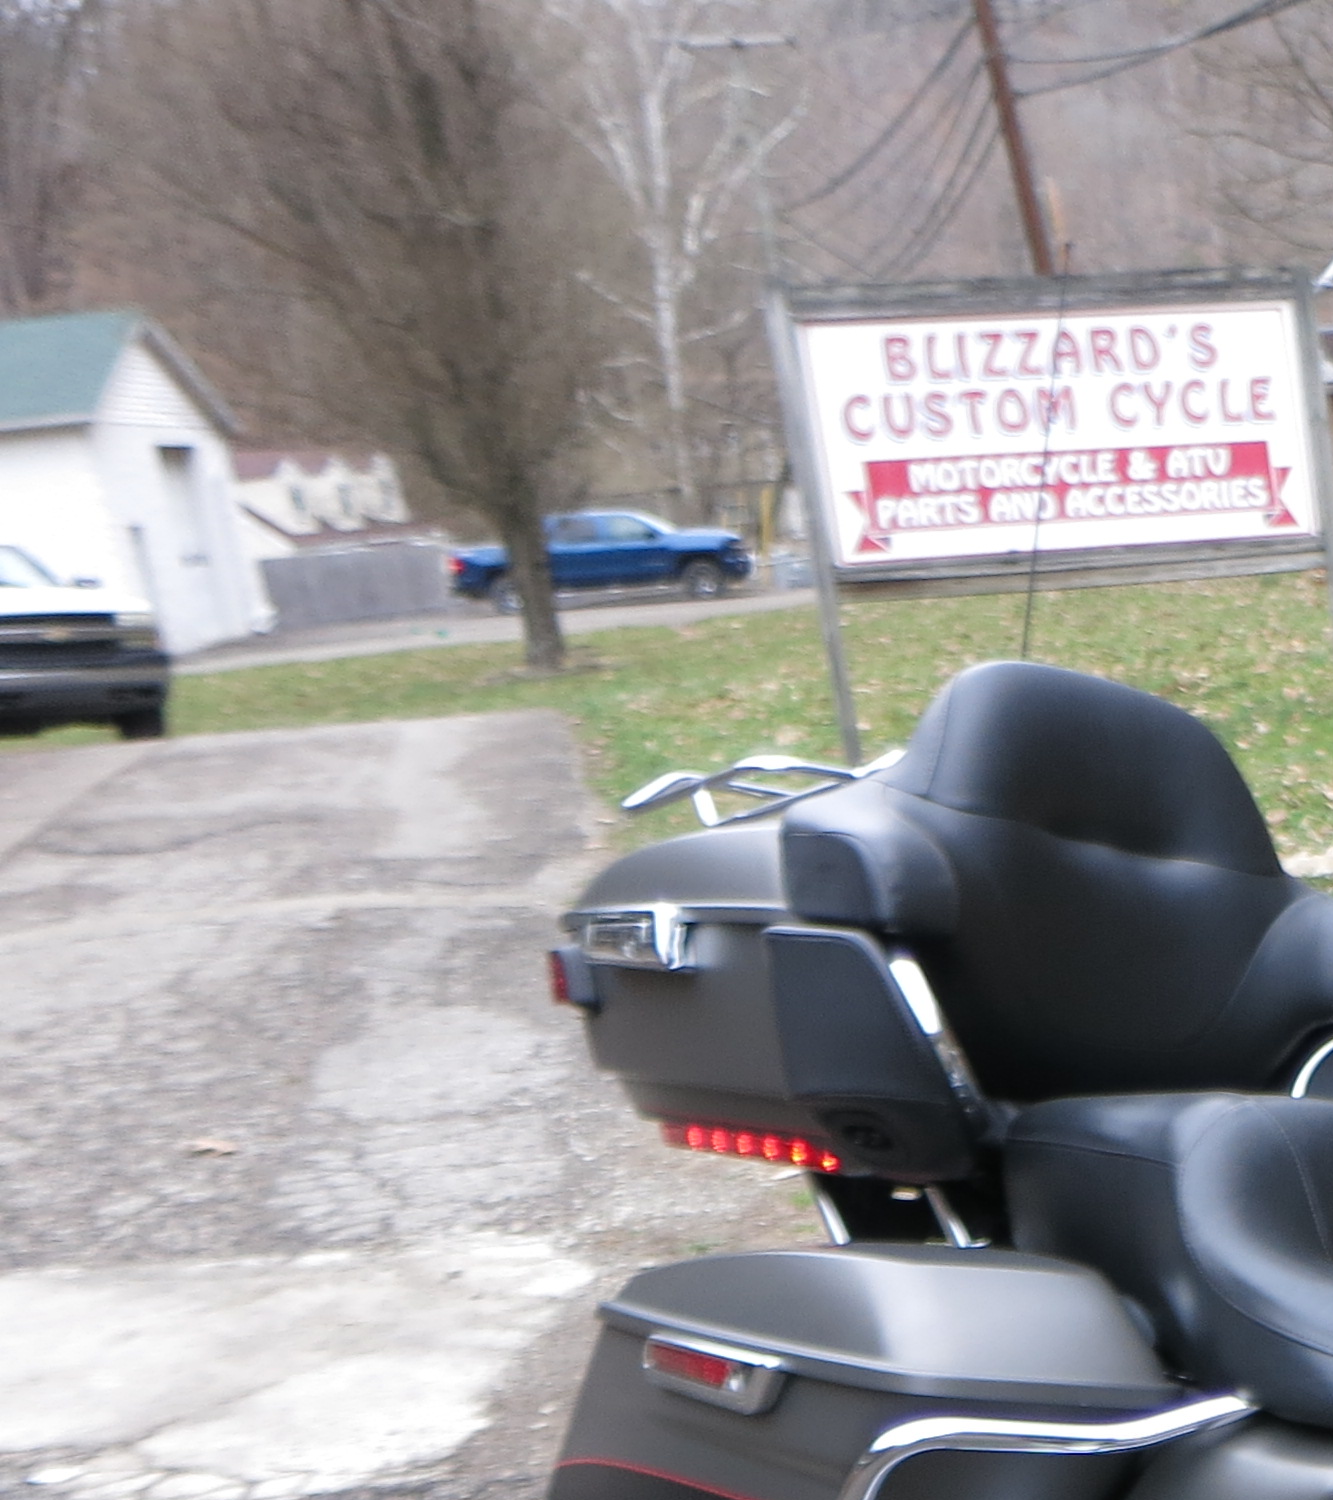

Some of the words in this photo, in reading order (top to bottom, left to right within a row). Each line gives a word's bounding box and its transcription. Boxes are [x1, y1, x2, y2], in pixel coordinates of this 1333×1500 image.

[882, 323, 1218, 383] BLIZZARD'S
[842, 386, 1078, 443] CUSTOM
[1109, 376, 1276, 430] CYCLE
[909, 452, 1118, 493] MOTORCYCLE
[1127, 451, 1158, 481] &
[876, 495, 983, 530] PARTS
[989, 489, 1059, 522] AND
[1064, 477, 1272, 520] ACCESSORIES
